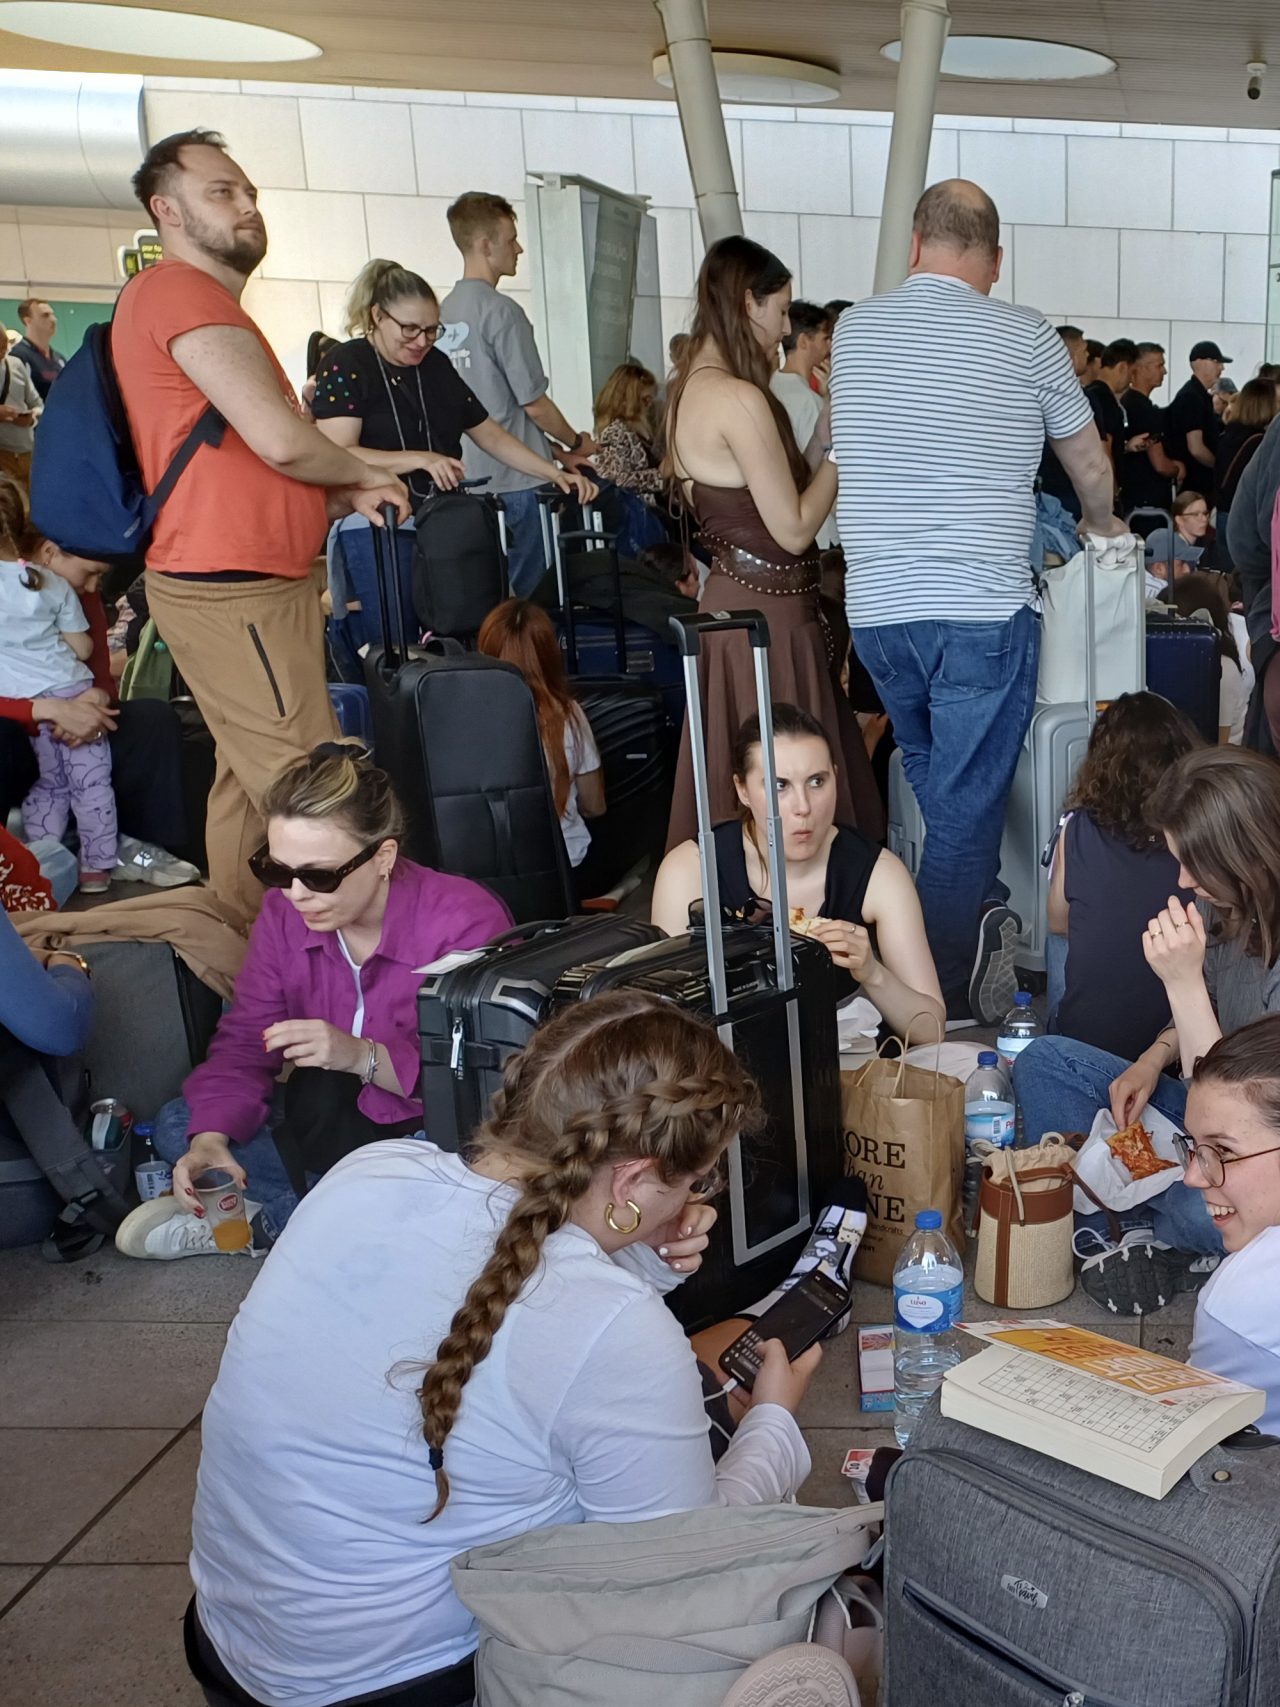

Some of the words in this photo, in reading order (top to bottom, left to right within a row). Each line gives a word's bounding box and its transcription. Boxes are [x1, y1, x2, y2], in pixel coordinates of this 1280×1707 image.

[843, 1129, 906, 1169] ORE
[846, 1157, 885, 1190] han
[866, 1193, 905, 1223] NE
